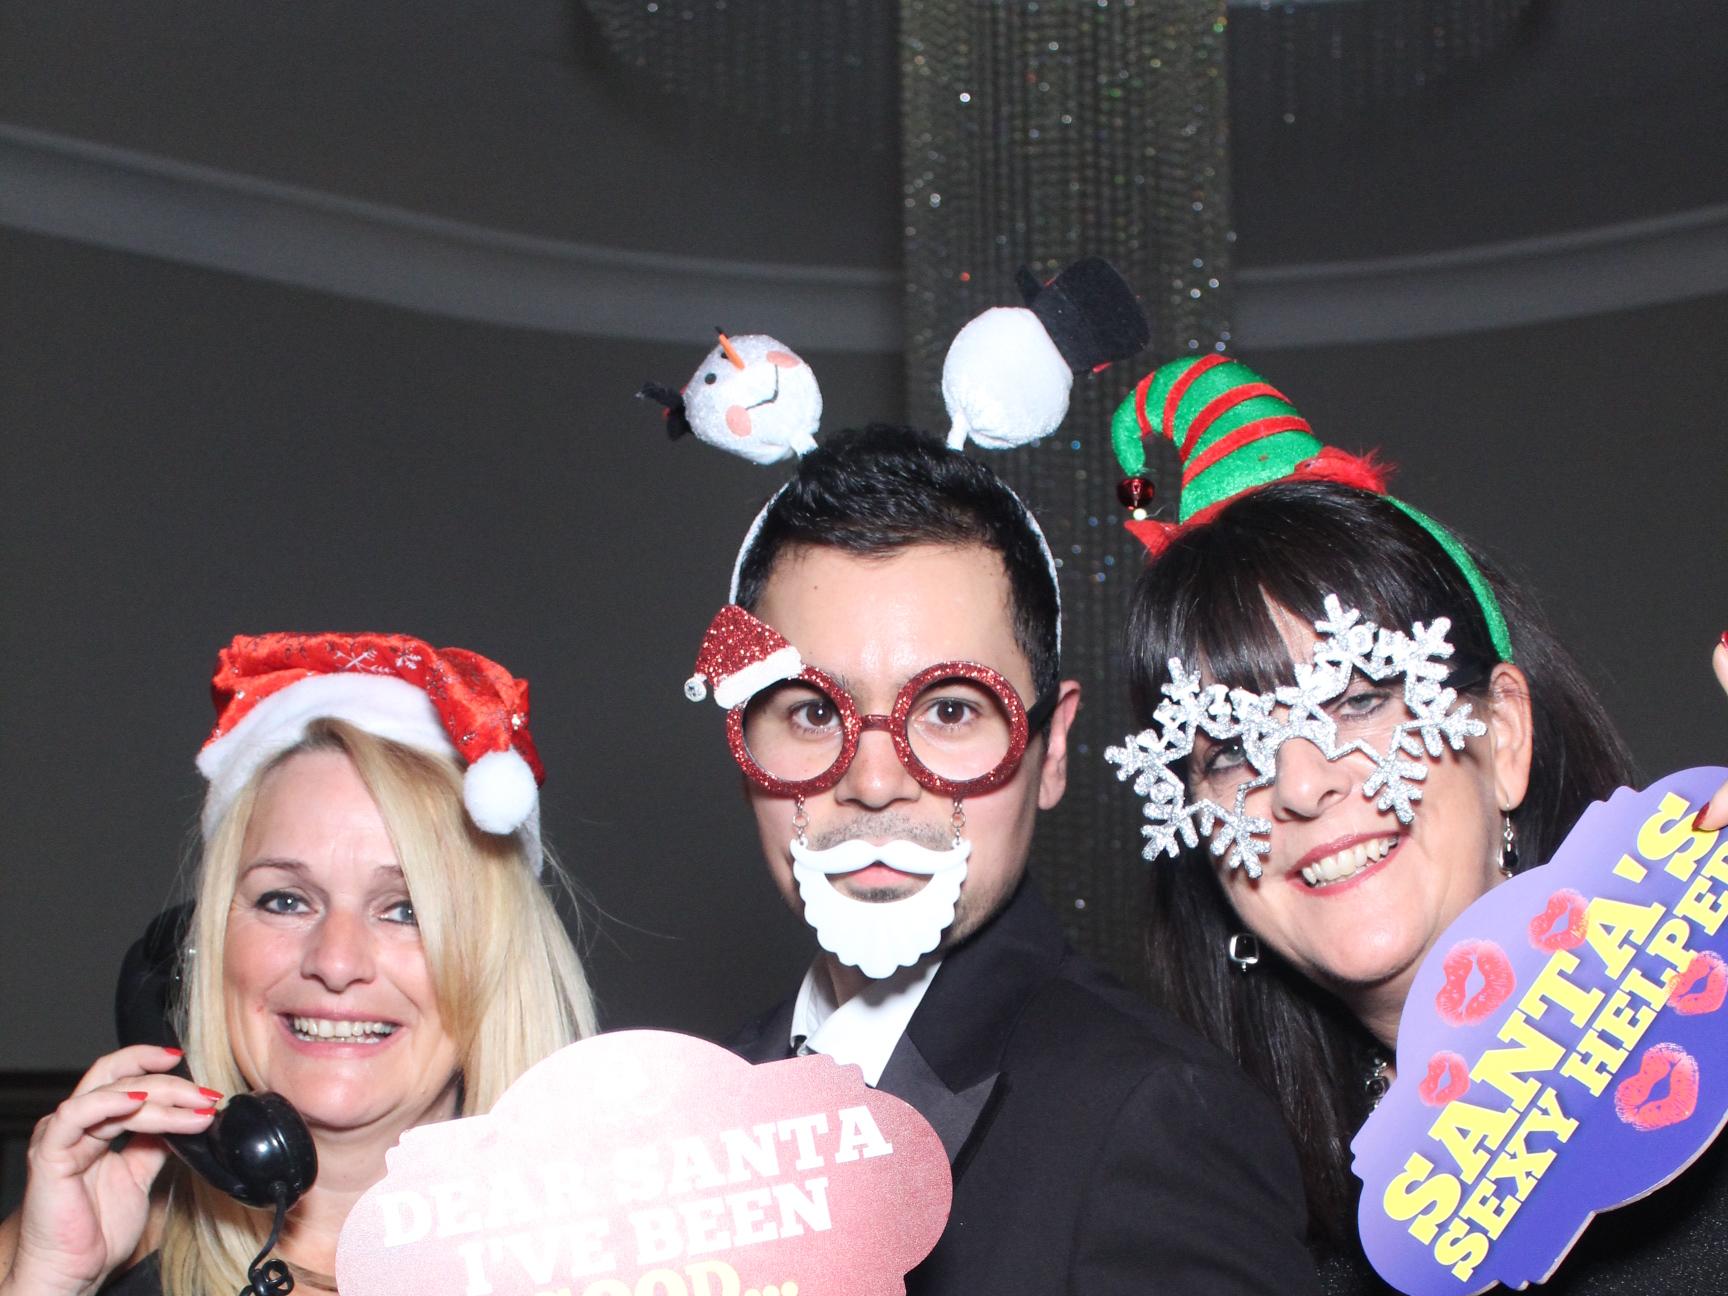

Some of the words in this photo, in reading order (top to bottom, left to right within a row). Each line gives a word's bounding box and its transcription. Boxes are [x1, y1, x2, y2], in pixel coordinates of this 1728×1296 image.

[1382, 791, 1720, 1246] SANTA'S
[377, 1156, 602, 1249] DEAR
[612, 1104, 894, 1203] SANTA
[628, 1175, 833, 1267] BEEN
[1433, 1087, 1581, 1283] SEXY
